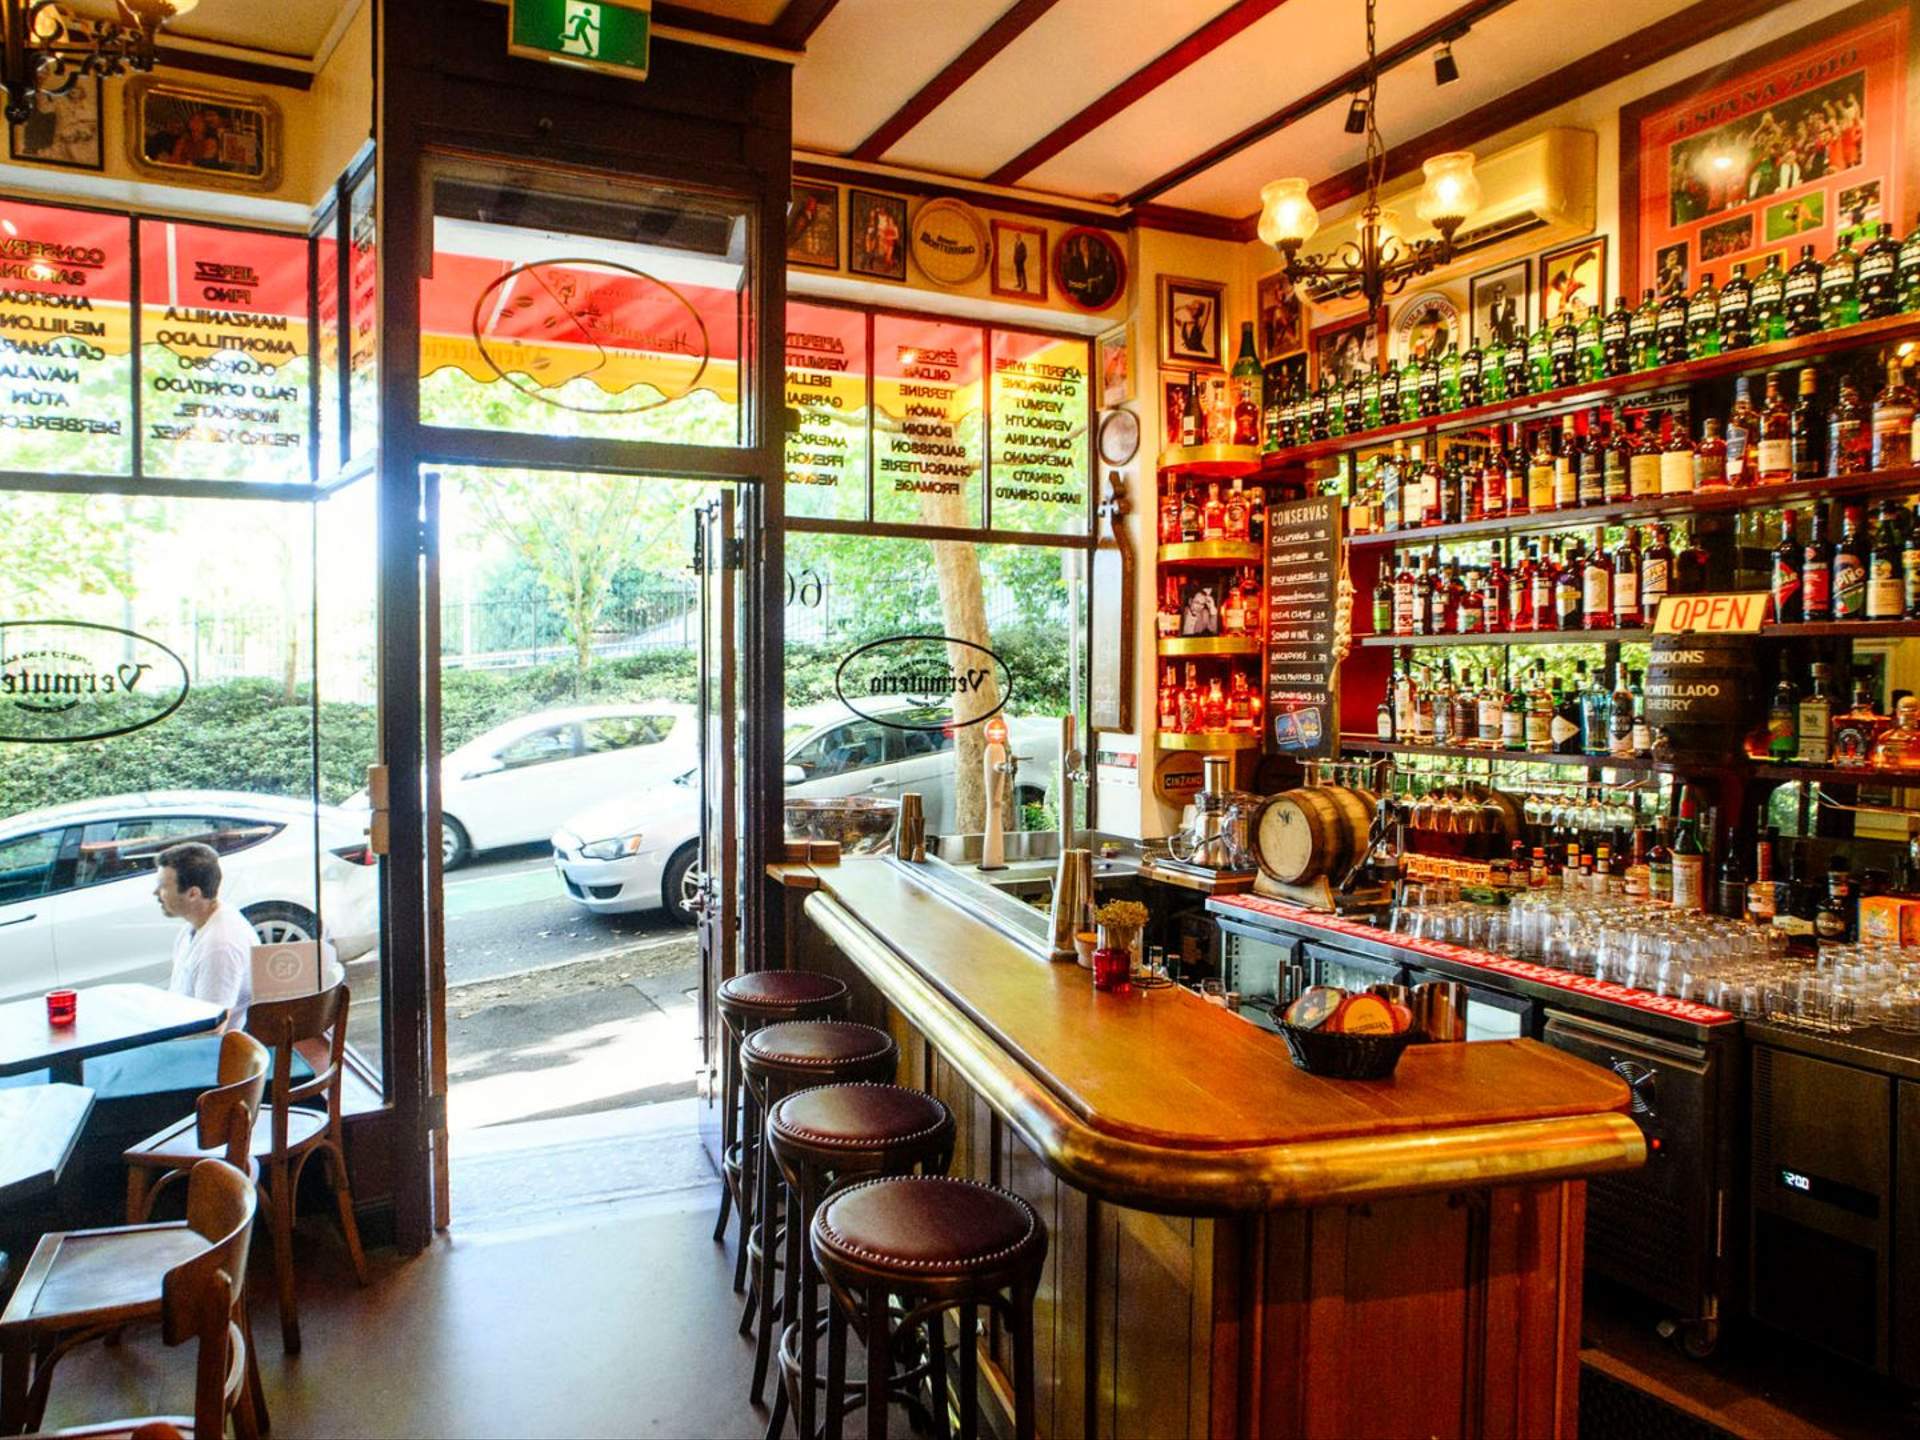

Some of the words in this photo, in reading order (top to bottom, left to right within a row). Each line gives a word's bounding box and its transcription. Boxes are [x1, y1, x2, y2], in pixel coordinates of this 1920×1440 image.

[1271, 504, 1329, 527] CONSERVAS
[1670, 597, 1751, 631] OPEN
[1645, 684, 1720, 698] ONTILLADO
